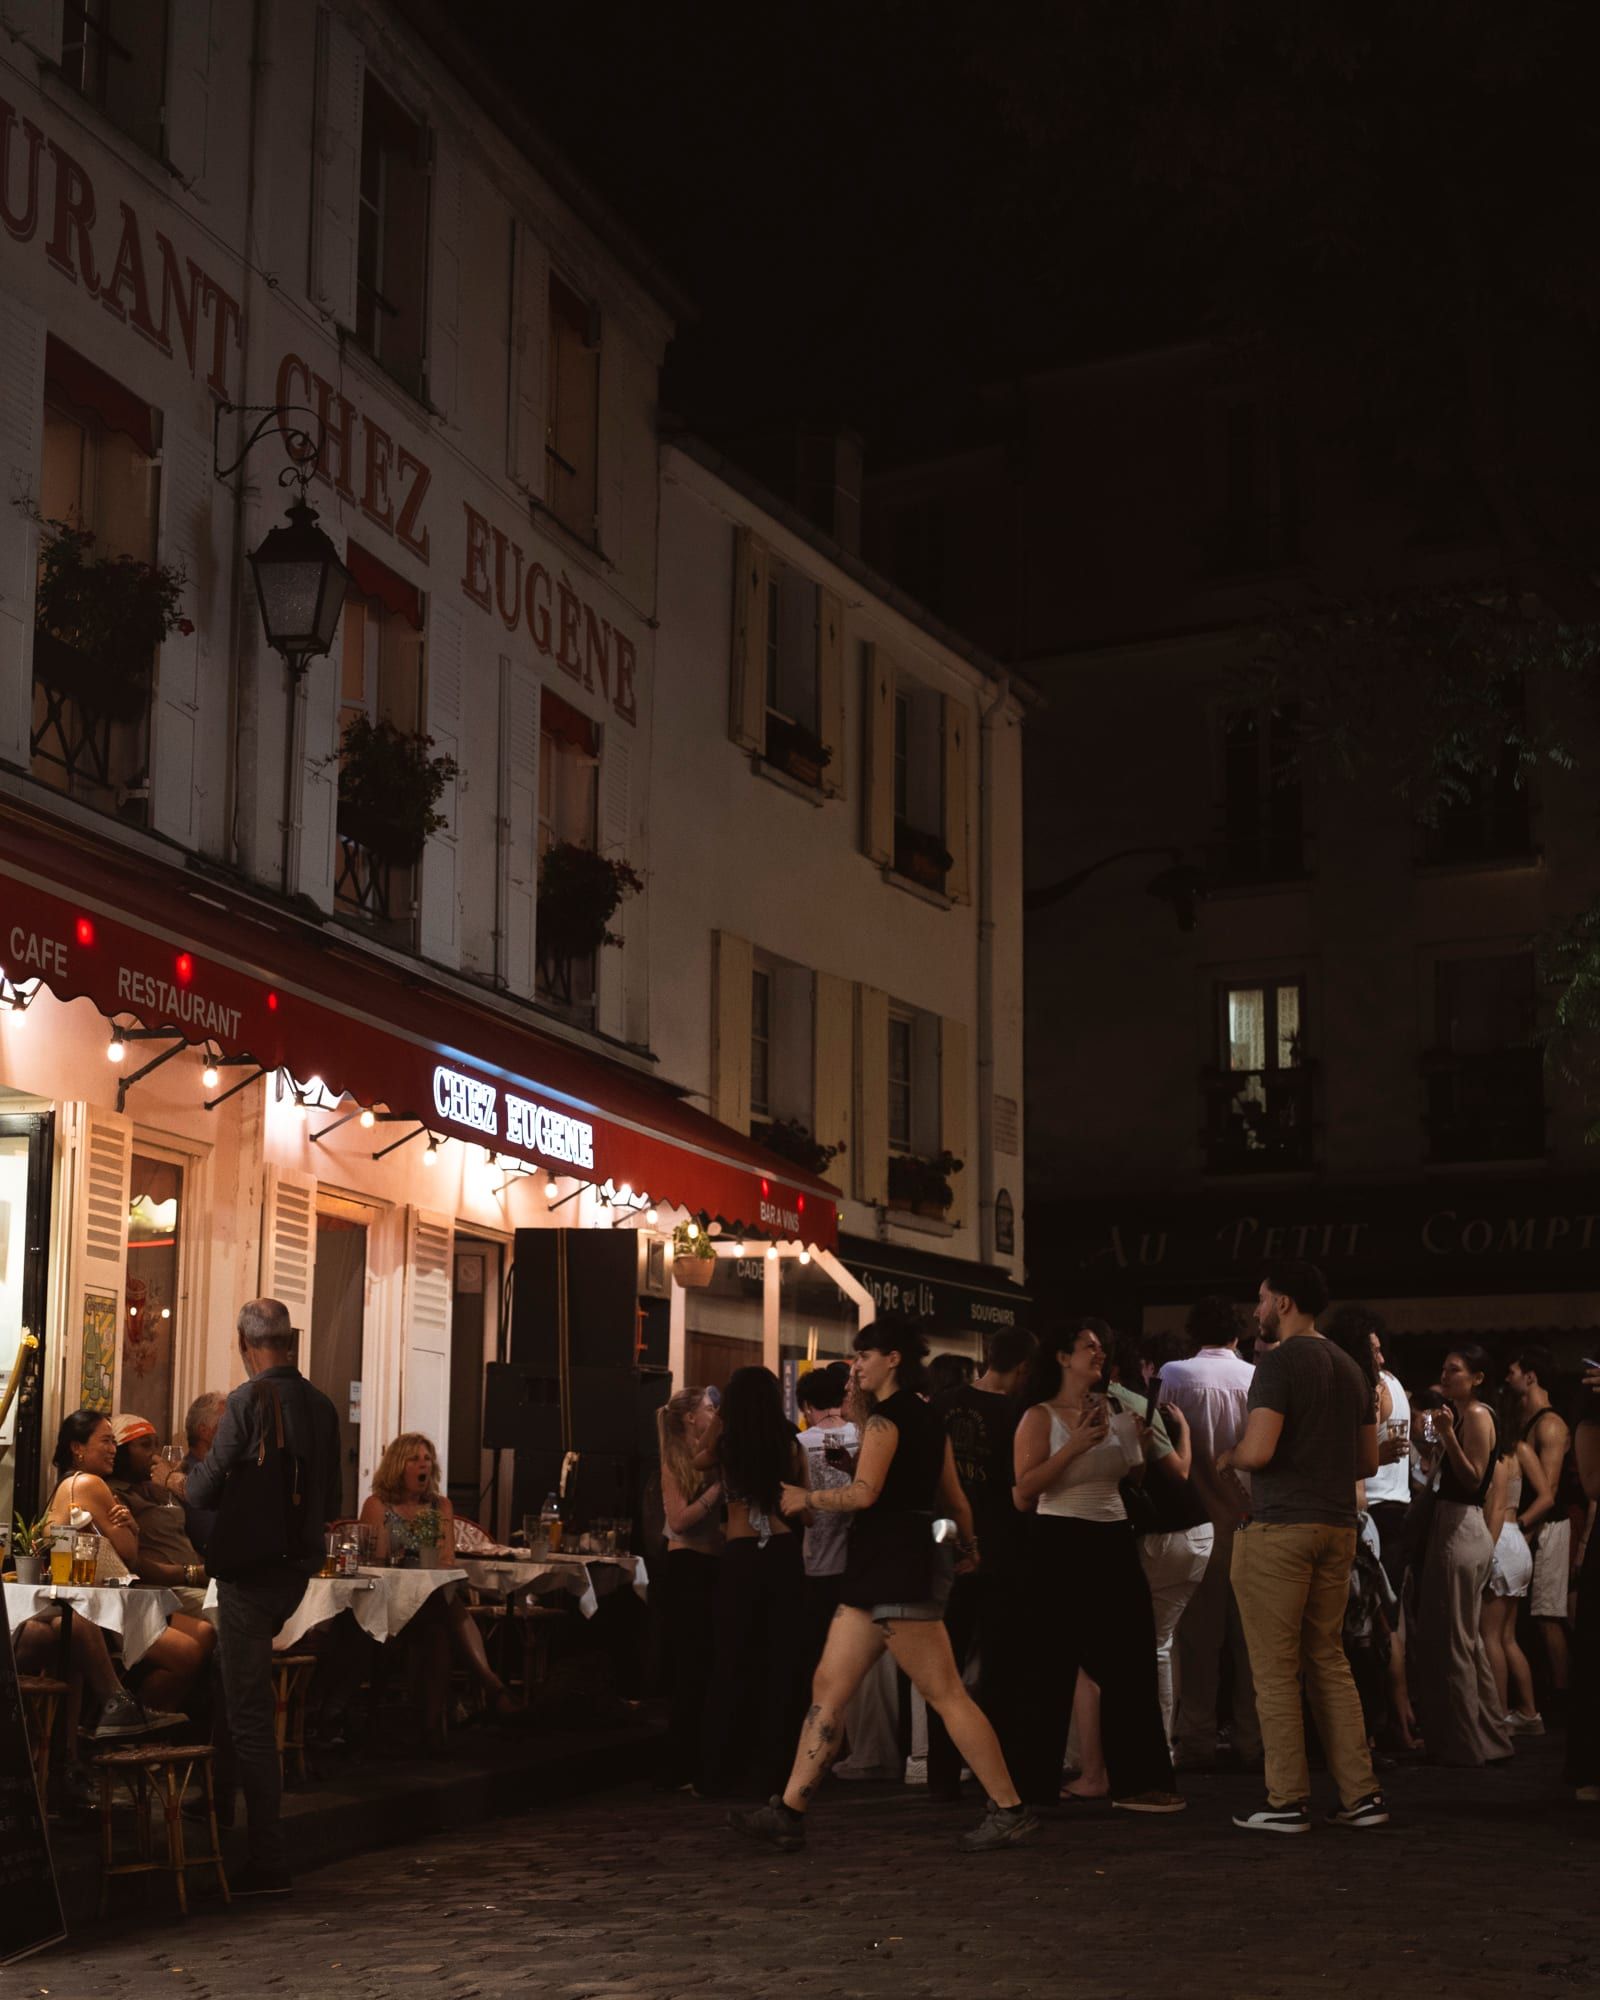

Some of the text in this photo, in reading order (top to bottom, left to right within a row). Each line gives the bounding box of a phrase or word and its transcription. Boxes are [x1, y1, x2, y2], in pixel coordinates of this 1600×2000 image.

[276, 353, 432, 566] CHEZ
[460, 501, 638, 728] EUGÈNE
[10, 926, 69, 979] CAFE
[117, 966, 242, 1041] RESTAURANT
[433, 1065, 594, 1169] CHEZ EUGENE
[760, 1201, 776, 1225] BAR
[782, 1209, 800, 1233] VINS
[970, 1303, 1016, 1326] SOUVENIRS
